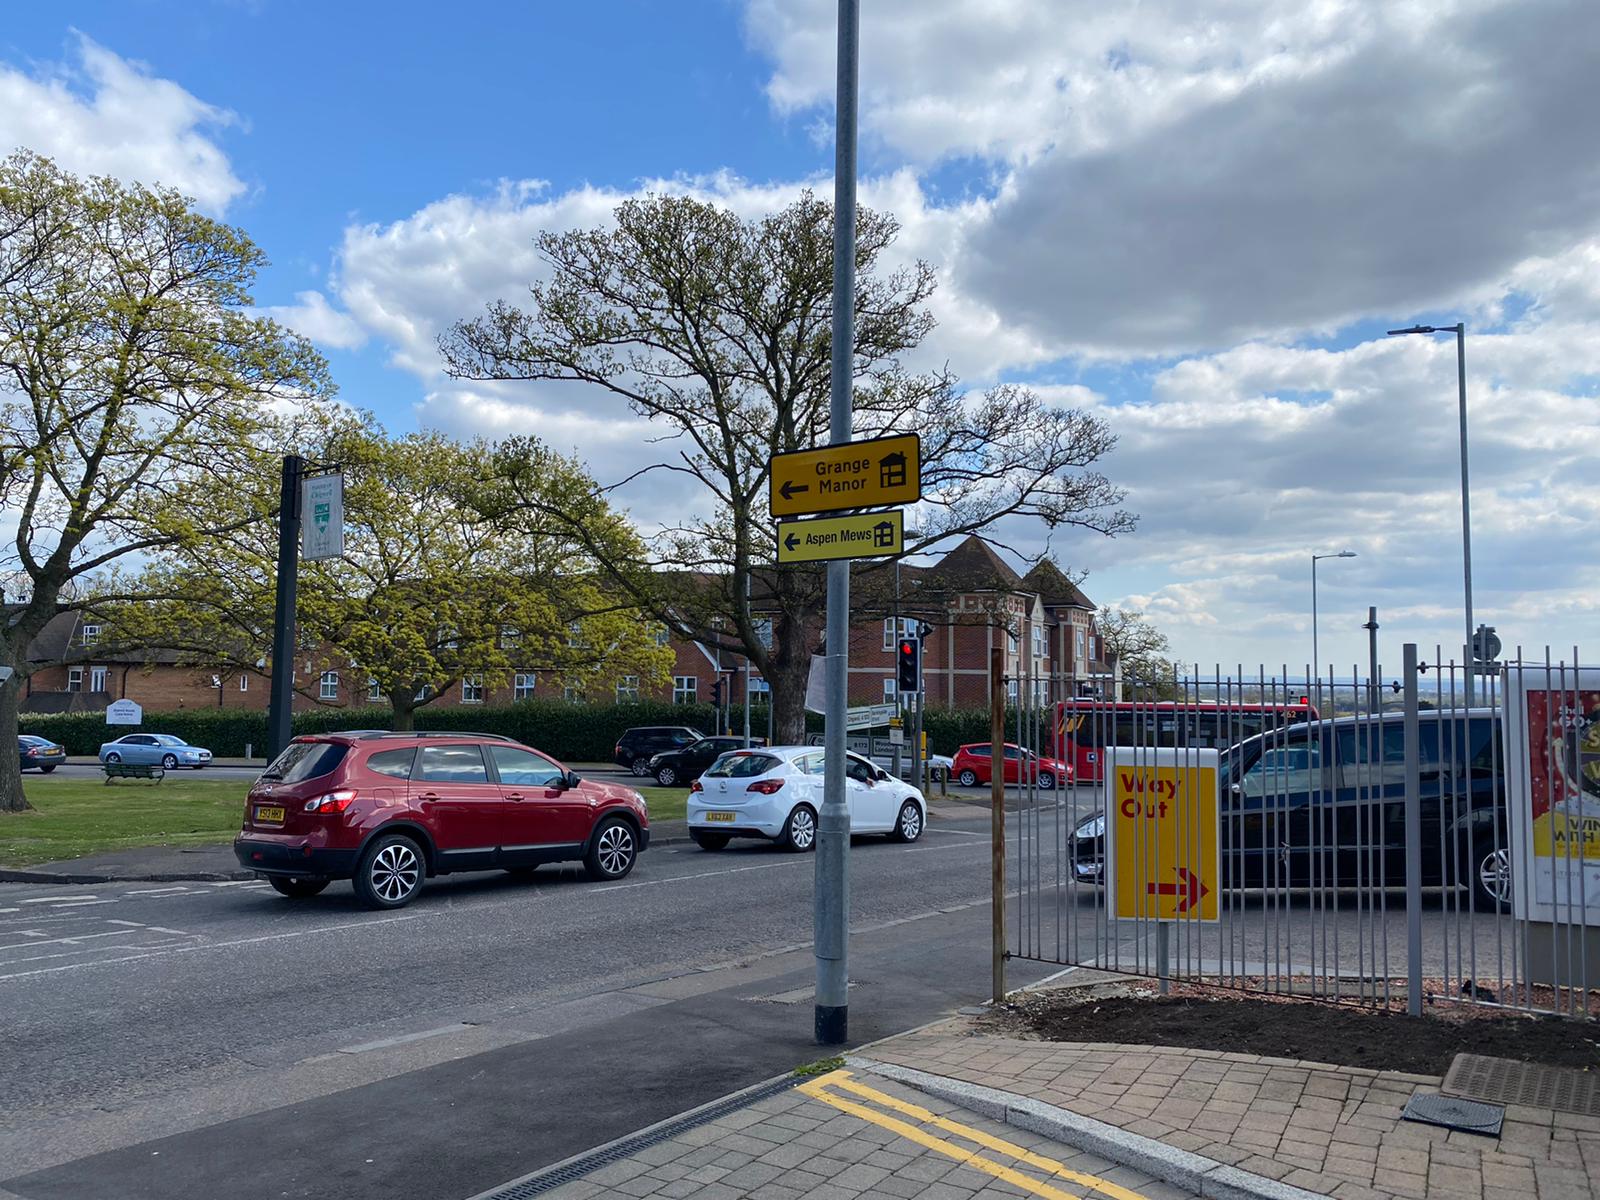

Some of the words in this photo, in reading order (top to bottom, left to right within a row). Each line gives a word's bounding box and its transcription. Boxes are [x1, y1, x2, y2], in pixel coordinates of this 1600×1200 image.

[815, 458, 870, 476] Grange
[819, 477, 868, 494] Manor
[805, 533, 838, 546] Aspen
[840, 530, 872, 542] Mews
[1121, 773, 1181, 799] Way
[1121, 799, 1168, 818] Out
[1553, 830, 1594, 843] WITH
